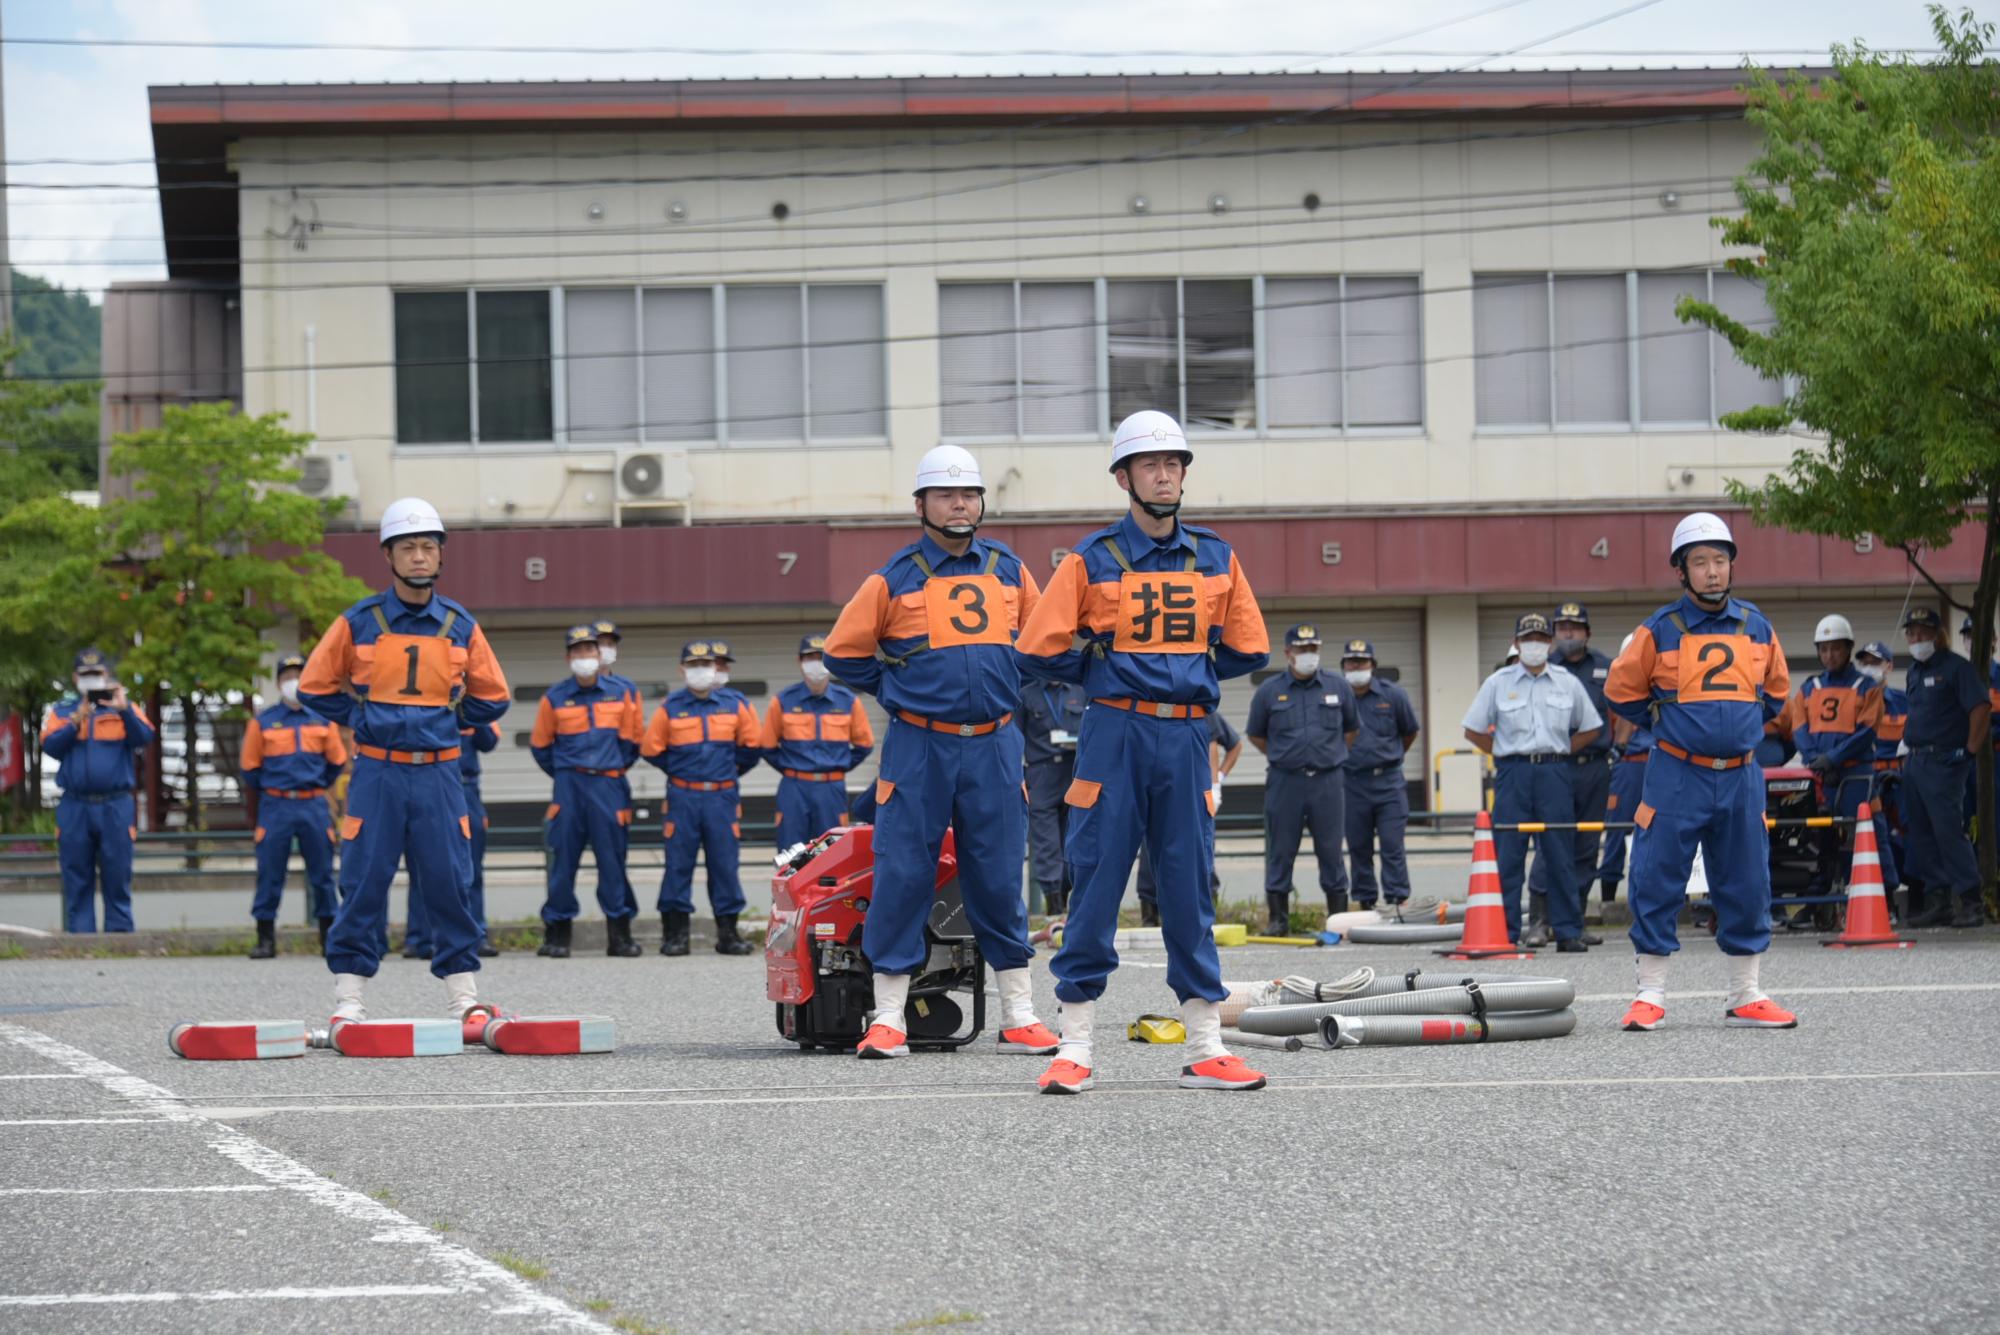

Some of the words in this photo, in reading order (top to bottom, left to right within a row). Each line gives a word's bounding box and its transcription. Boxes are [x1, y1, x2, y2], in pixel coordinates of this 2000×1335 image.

[1321, 542, 1343, 564] 5
[1590, 537, 1608, 560] 4
[525, 557, 547, 580] 8
[777, 552, 798, 575] 7
[948, 583, 989, 635] 3
[1131, 582, 1196, 643] 指
[398, 644, 422, 696] 1
[1698, 642, 1738, 692] 2
[1821, 697, 1839, 722] 3
